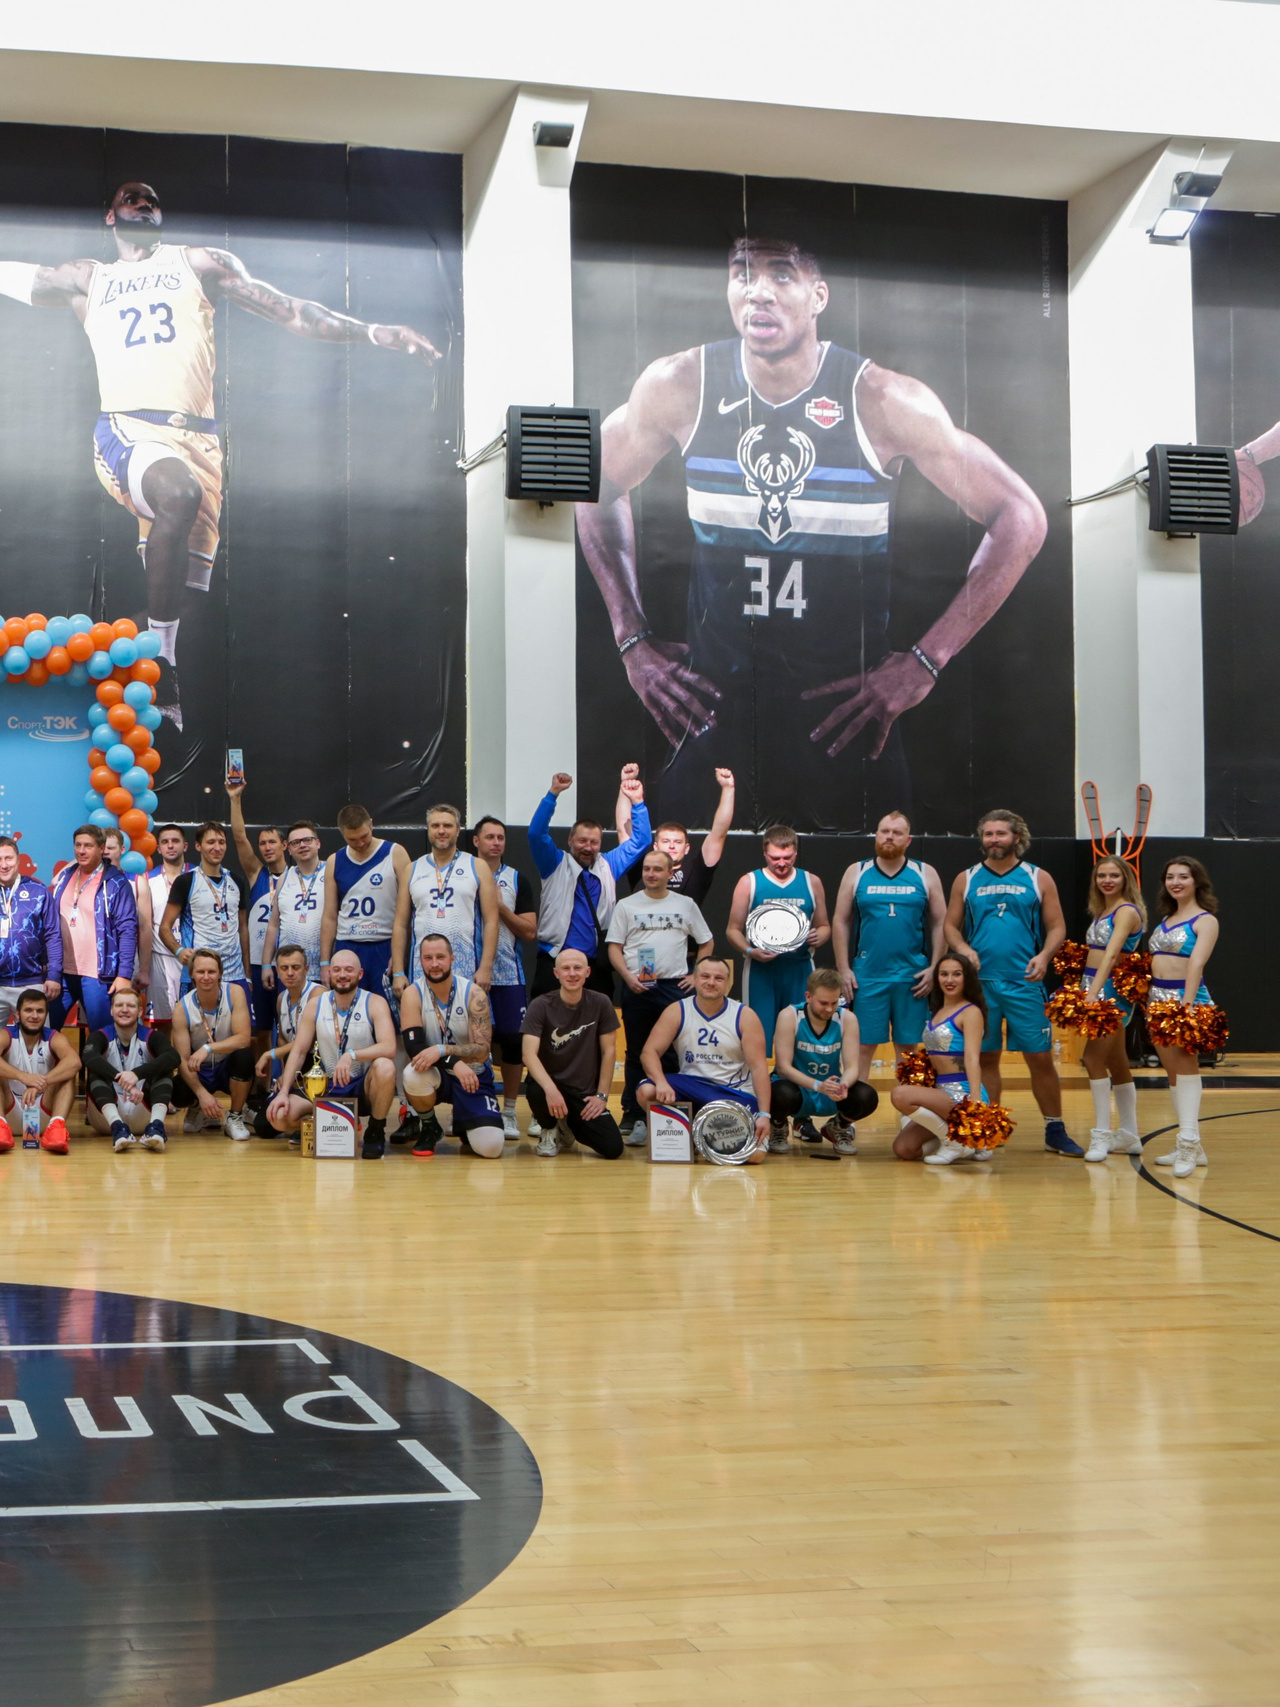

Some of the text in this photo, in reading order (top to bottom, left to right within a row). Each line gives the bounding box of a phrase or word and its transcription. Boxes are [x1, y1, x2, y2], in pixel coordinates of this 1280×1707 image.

[99, 272, 182, 307] LAKERS
[119, 302, 176, 349] 23
[743, 554, 808, 618] 34
[866, 885, 916, 895] СИБУР
[976, 884, 1027, 896] СИБУР
[294, 893, 317, 911] 25
[430, 887, 454, 908] 32
[348, 897, 376, 918] 20
[888, 903, 896, 917] 1
[996, 903, 1007, 917] 7
[698, 1028, 719, 1047] 24
[797, 1041, 842, 1054] СИБУР
[807, 1061, 831, 1076] 33
[321, 1125, 349, 1133] ДИПЛОМ
[656, 1129, 684, 1137] ДИПЛОМ
[716, 1126, 745, 1137] ТУРНИР
